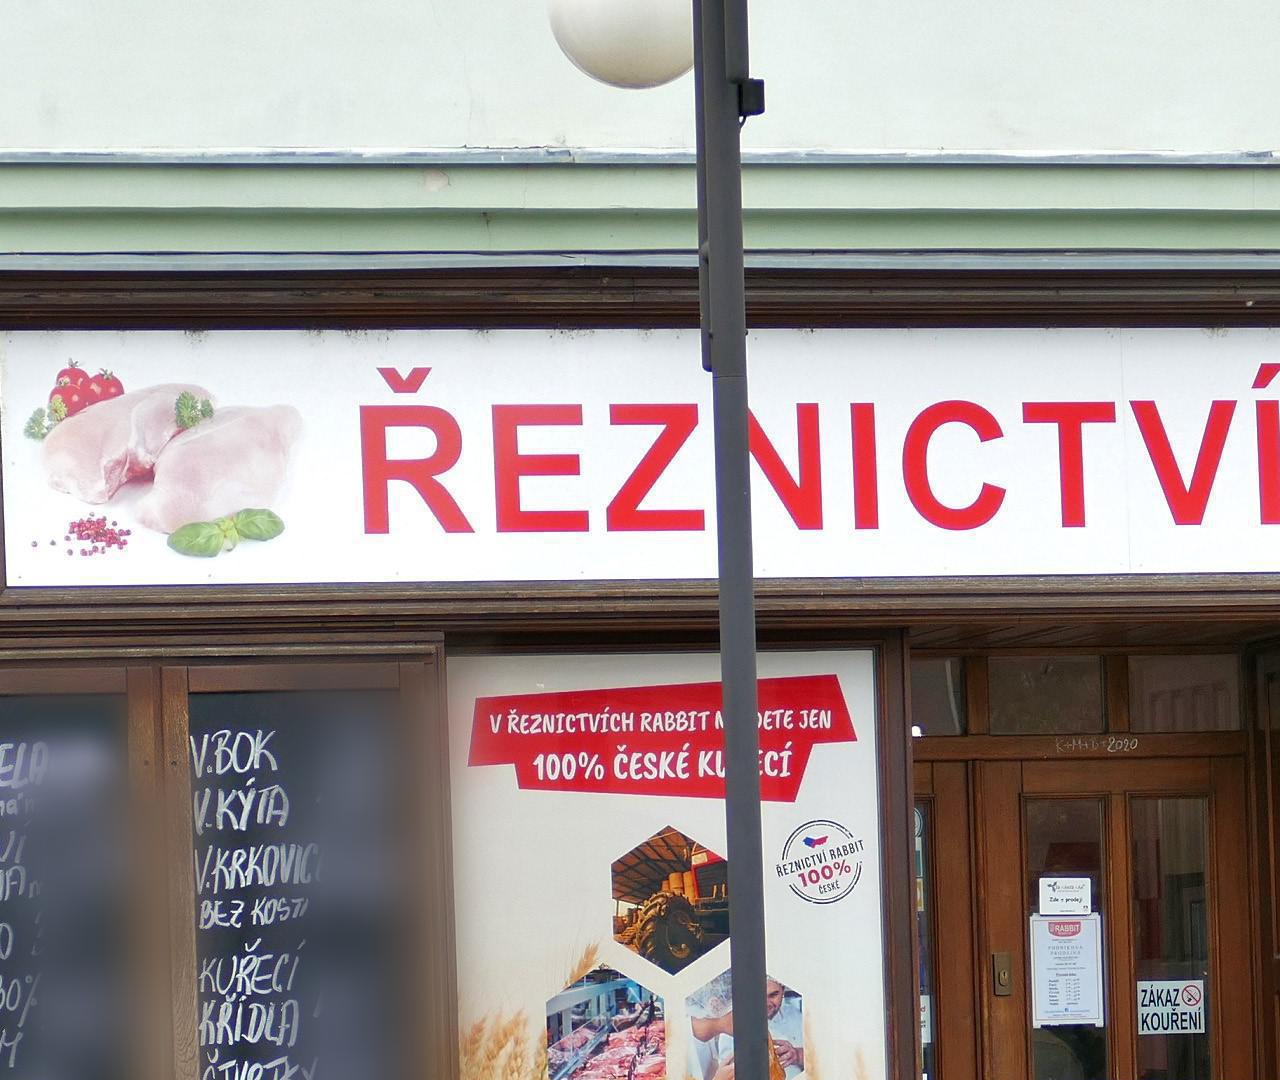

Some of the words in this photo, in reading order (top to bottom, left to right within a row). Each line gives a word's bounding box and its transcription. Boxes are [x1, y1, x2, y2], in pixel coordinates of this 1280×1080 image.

[489, 714, 502, 734] V
[506, 704, 635, 735] ŘEZNICTVÍCH
[640, 710, 710, 734] RABBIT
[714, 709, 794, 731] NETE
[798, 709, 832, 729] JEN
[532, 750, 604, 781] 100%
[613, 743, 690, 780] ČESKÉ
[776, 848, 828, 878] ŘEZNICTVÍ
[829, 839, 866, 861] RABBIT
[798, 859, 851, 888] 100%
[818, 879, 841, 895] ČESKÉ
[199, 899, 246, 930] BEZ
[199, 938, 307, 995] KUŘECÍ
[1141, 984, 1180, 1007] ZÁKAZ
[199, 992, 299, 1048] KŘÍDLA
[1141, 1007, 1202, 1031] KOUŘENÍ
